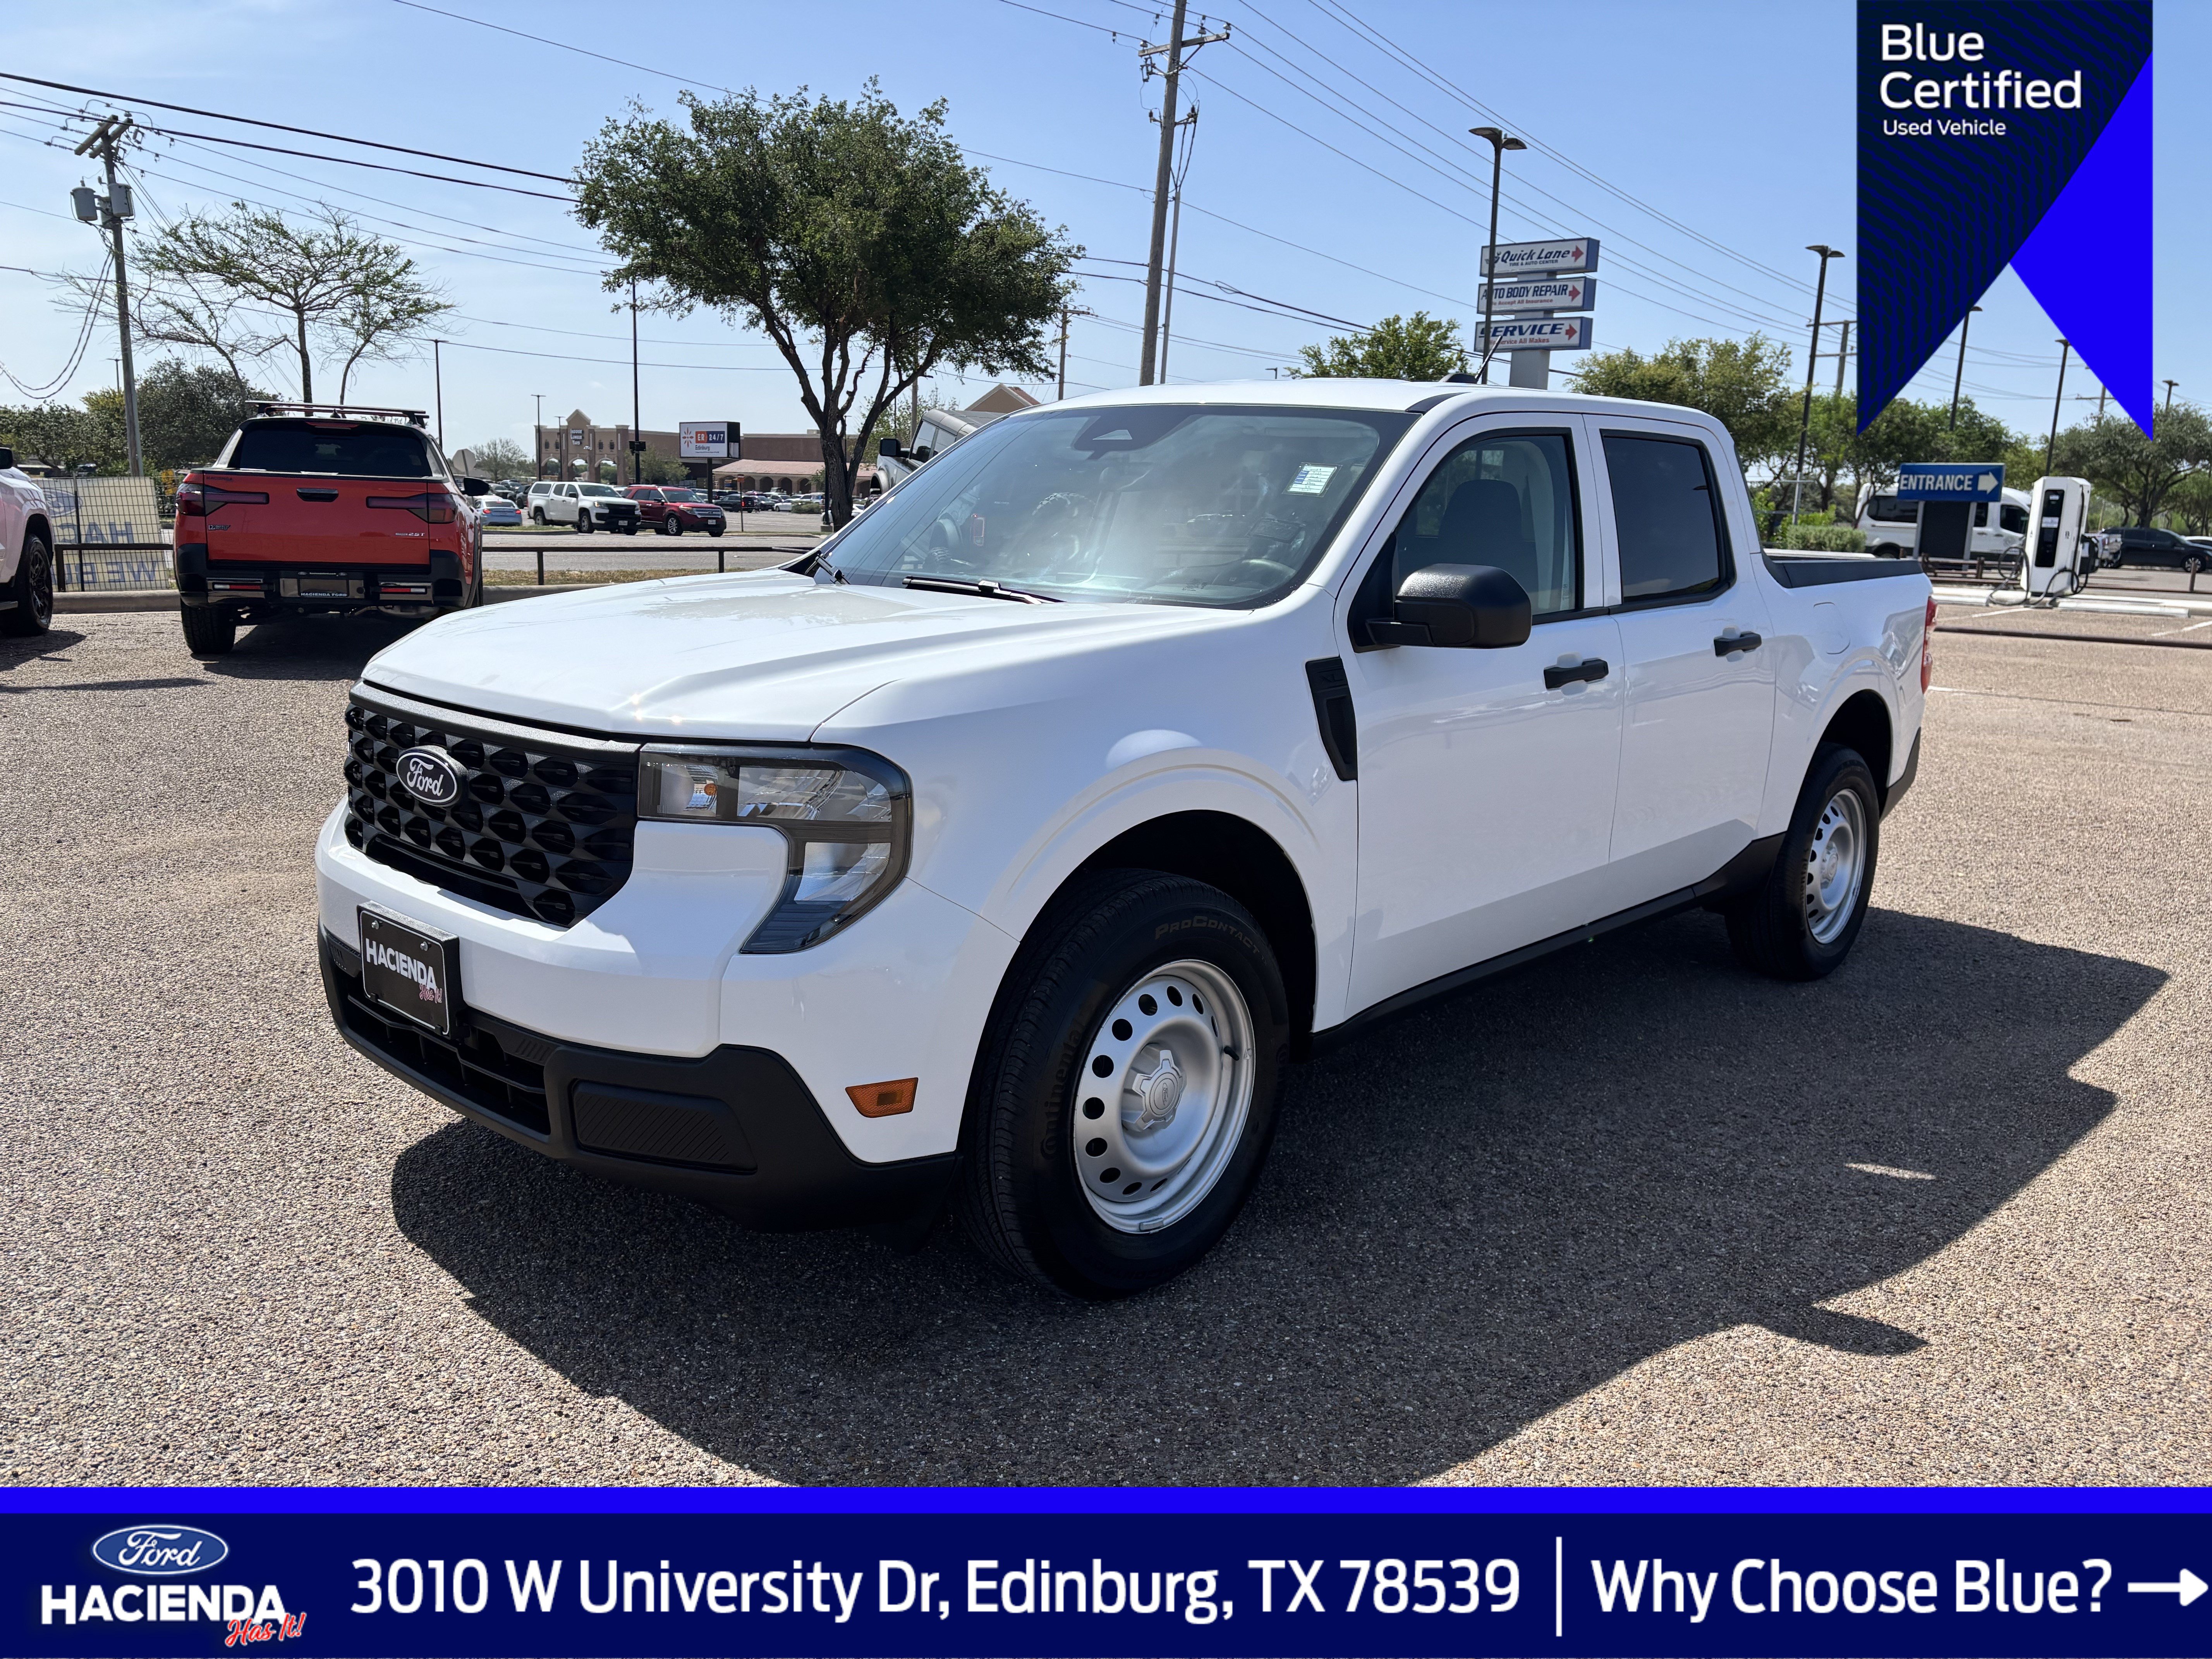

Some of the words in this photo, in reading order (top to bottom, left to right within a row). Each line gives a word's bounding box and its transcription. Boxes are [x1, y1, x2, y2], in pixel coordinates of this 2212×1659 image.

[1501, 249, 1536, 263] Quick
[1537, 248, 1570, 260] Lane
[1481, 288, 1505, 300] ATO
[1506, 286, 1532, 299] BODY
[1532, 284, 1568, 297] REPAIR
[1899, 474, 1973, 491] ENTRANCE
[406, 757, 443, 797] Ford
[366, 938, 438, 993] HACIENDA
